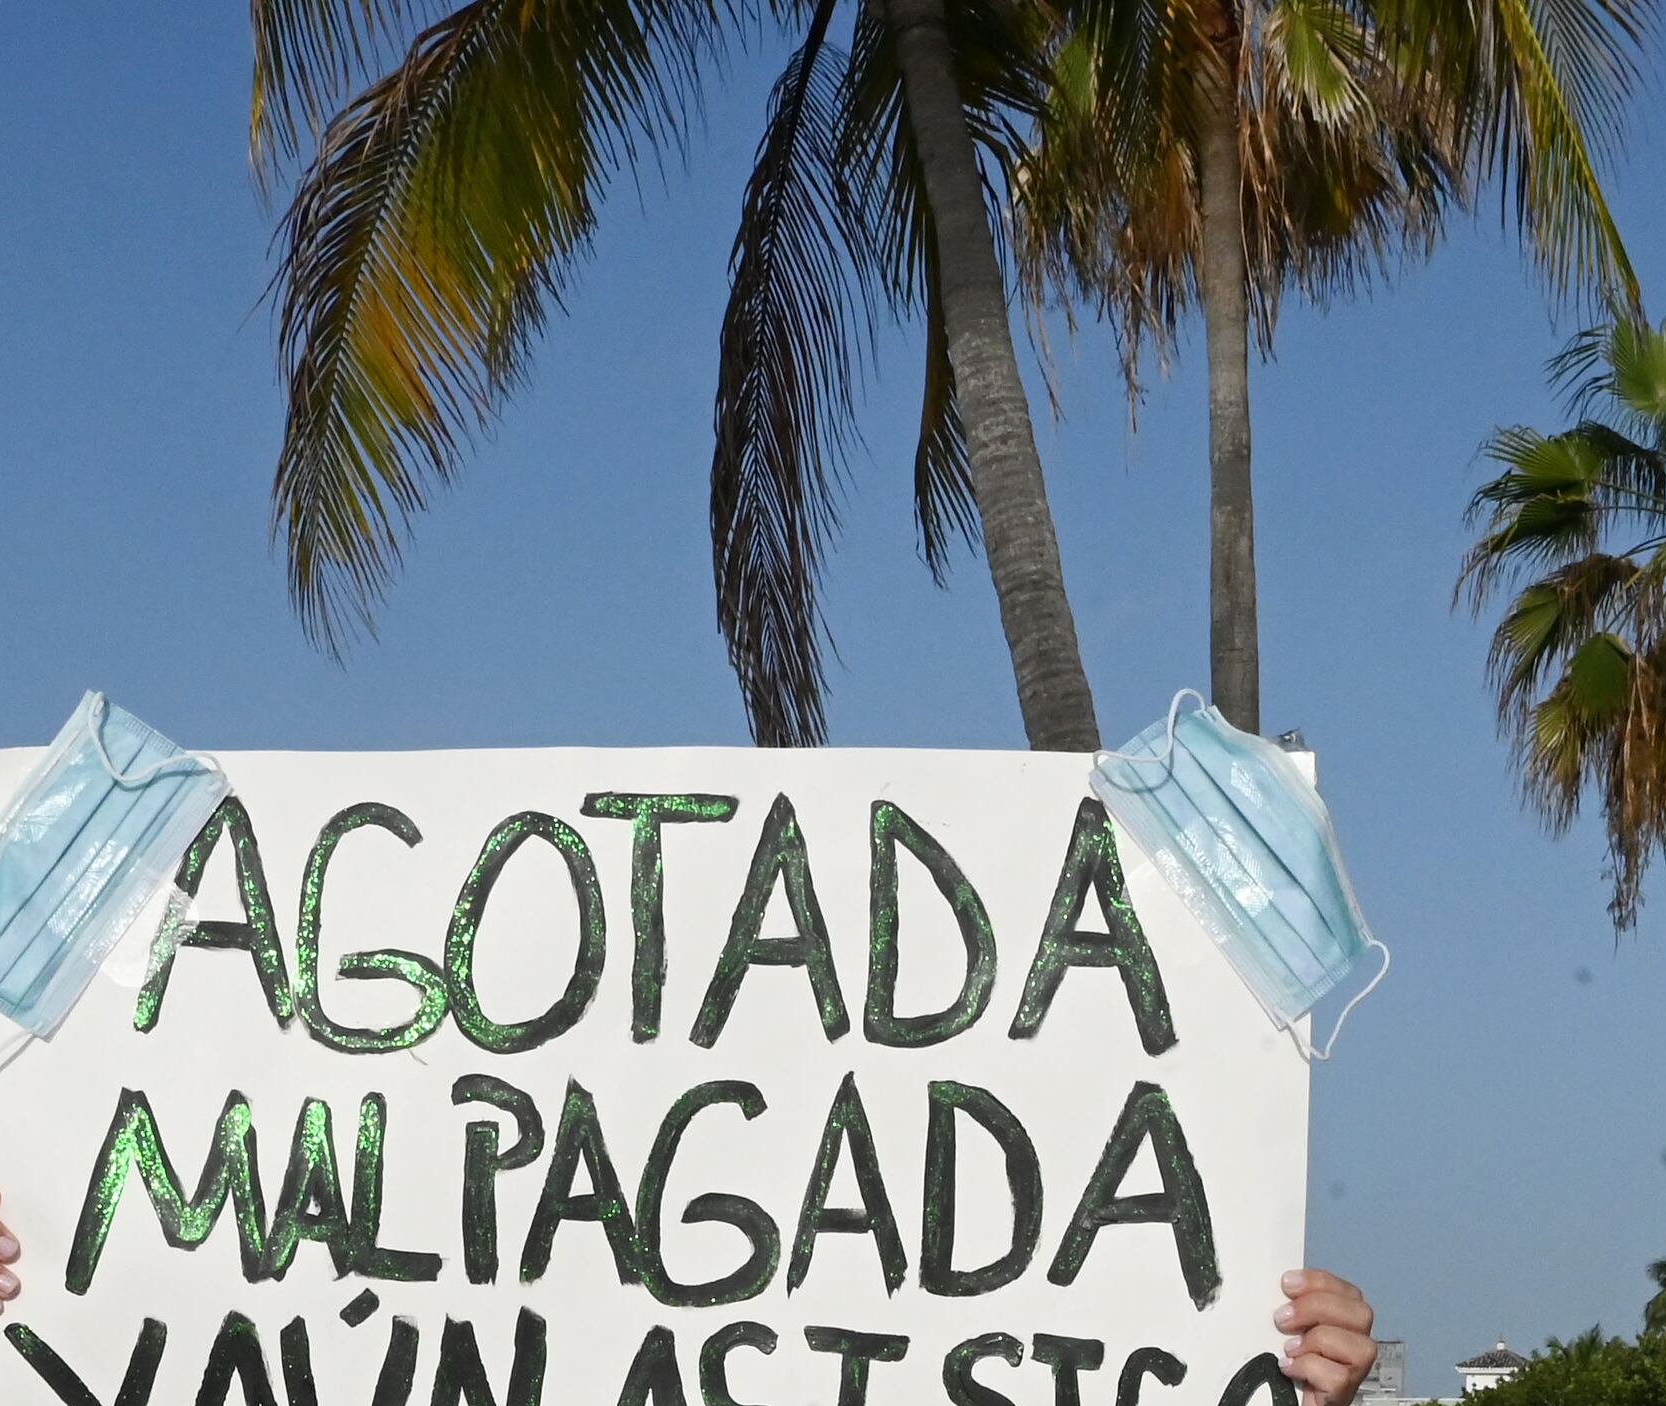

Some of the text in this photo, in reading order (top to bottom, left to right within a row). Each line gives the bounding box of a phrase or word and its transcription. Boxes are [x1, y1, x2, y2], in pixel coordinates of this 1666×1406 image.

[133, 792, 1181, 1056] AGOTADA
[64, 1071, 1223, 1311] MAL PAGADA
